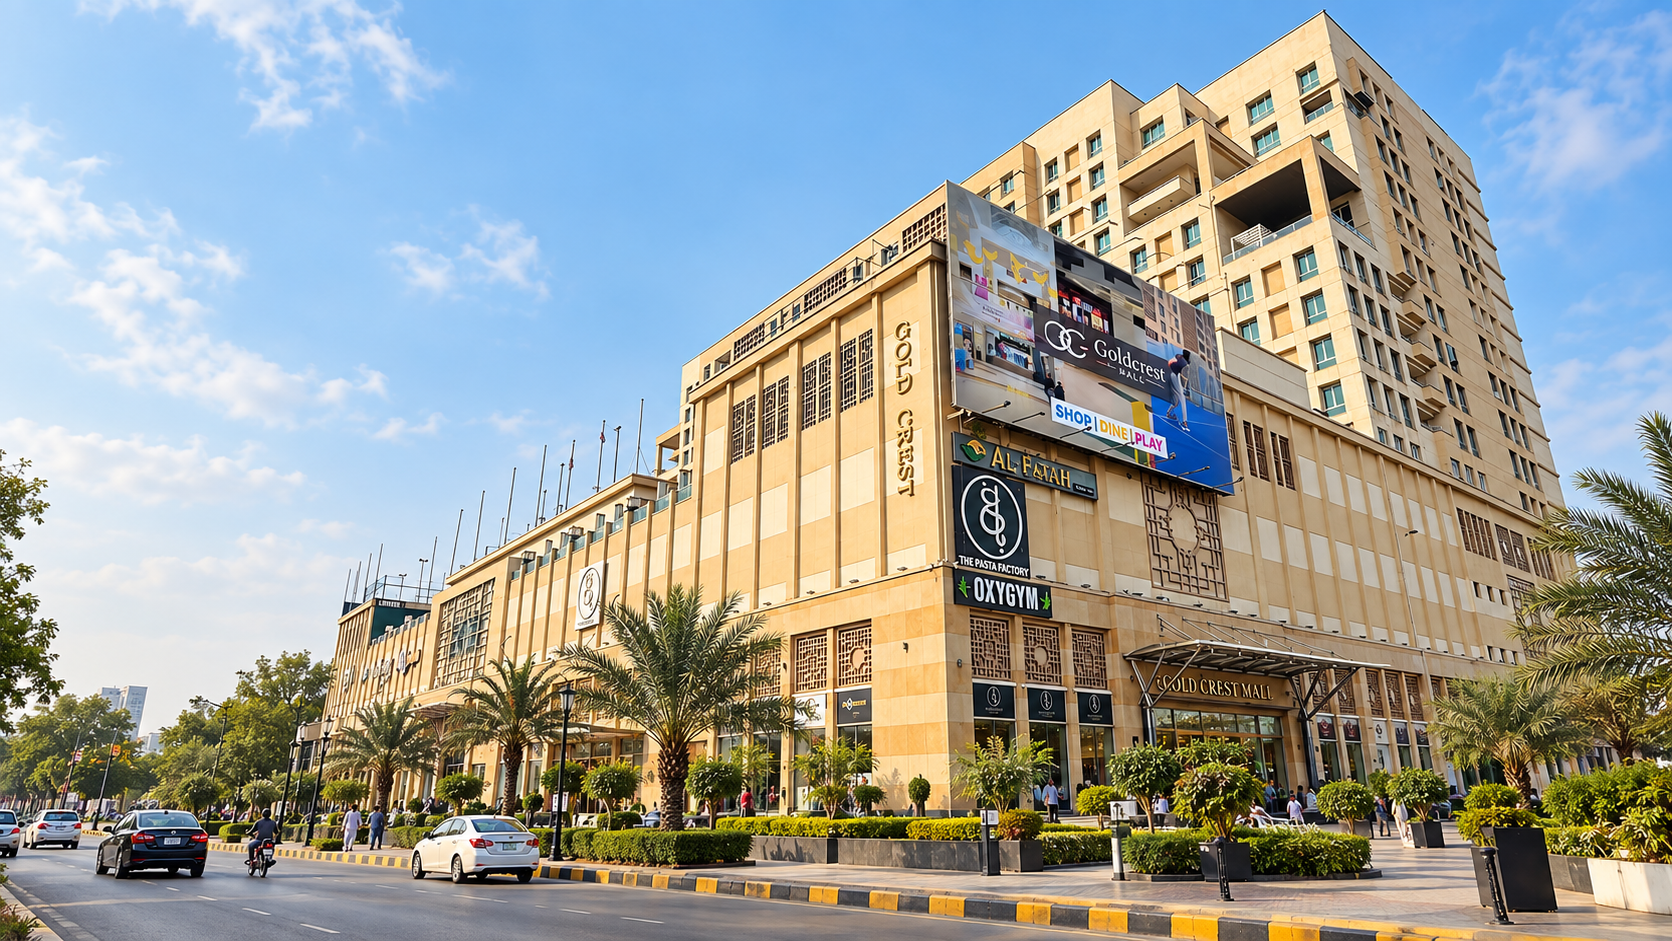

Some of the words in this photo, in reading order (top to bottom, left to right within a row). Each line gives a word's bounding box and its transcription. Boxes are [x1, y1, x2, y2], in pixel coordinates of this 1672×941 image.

[894, 320, 914, 395] GOLD
[1094, 339, 1166, 383] Goldcrest
[1055, 403, 1092, 427] SHOP
[1099, 418, 1128, 441] DINE
[1134, 431, 1163, 452] PLAY
[896, 408, 915, 497] CREST
[958, 555, 974, 567] THE
[974, 558, 997, 572] PASTA
[997, 562, 1030, 577] FACTORY
[973, 576, 1039, 611] OXYGYM
[1200, 678, 1239, 698] CREST
[1241, 682, 1274, 700] MALL
